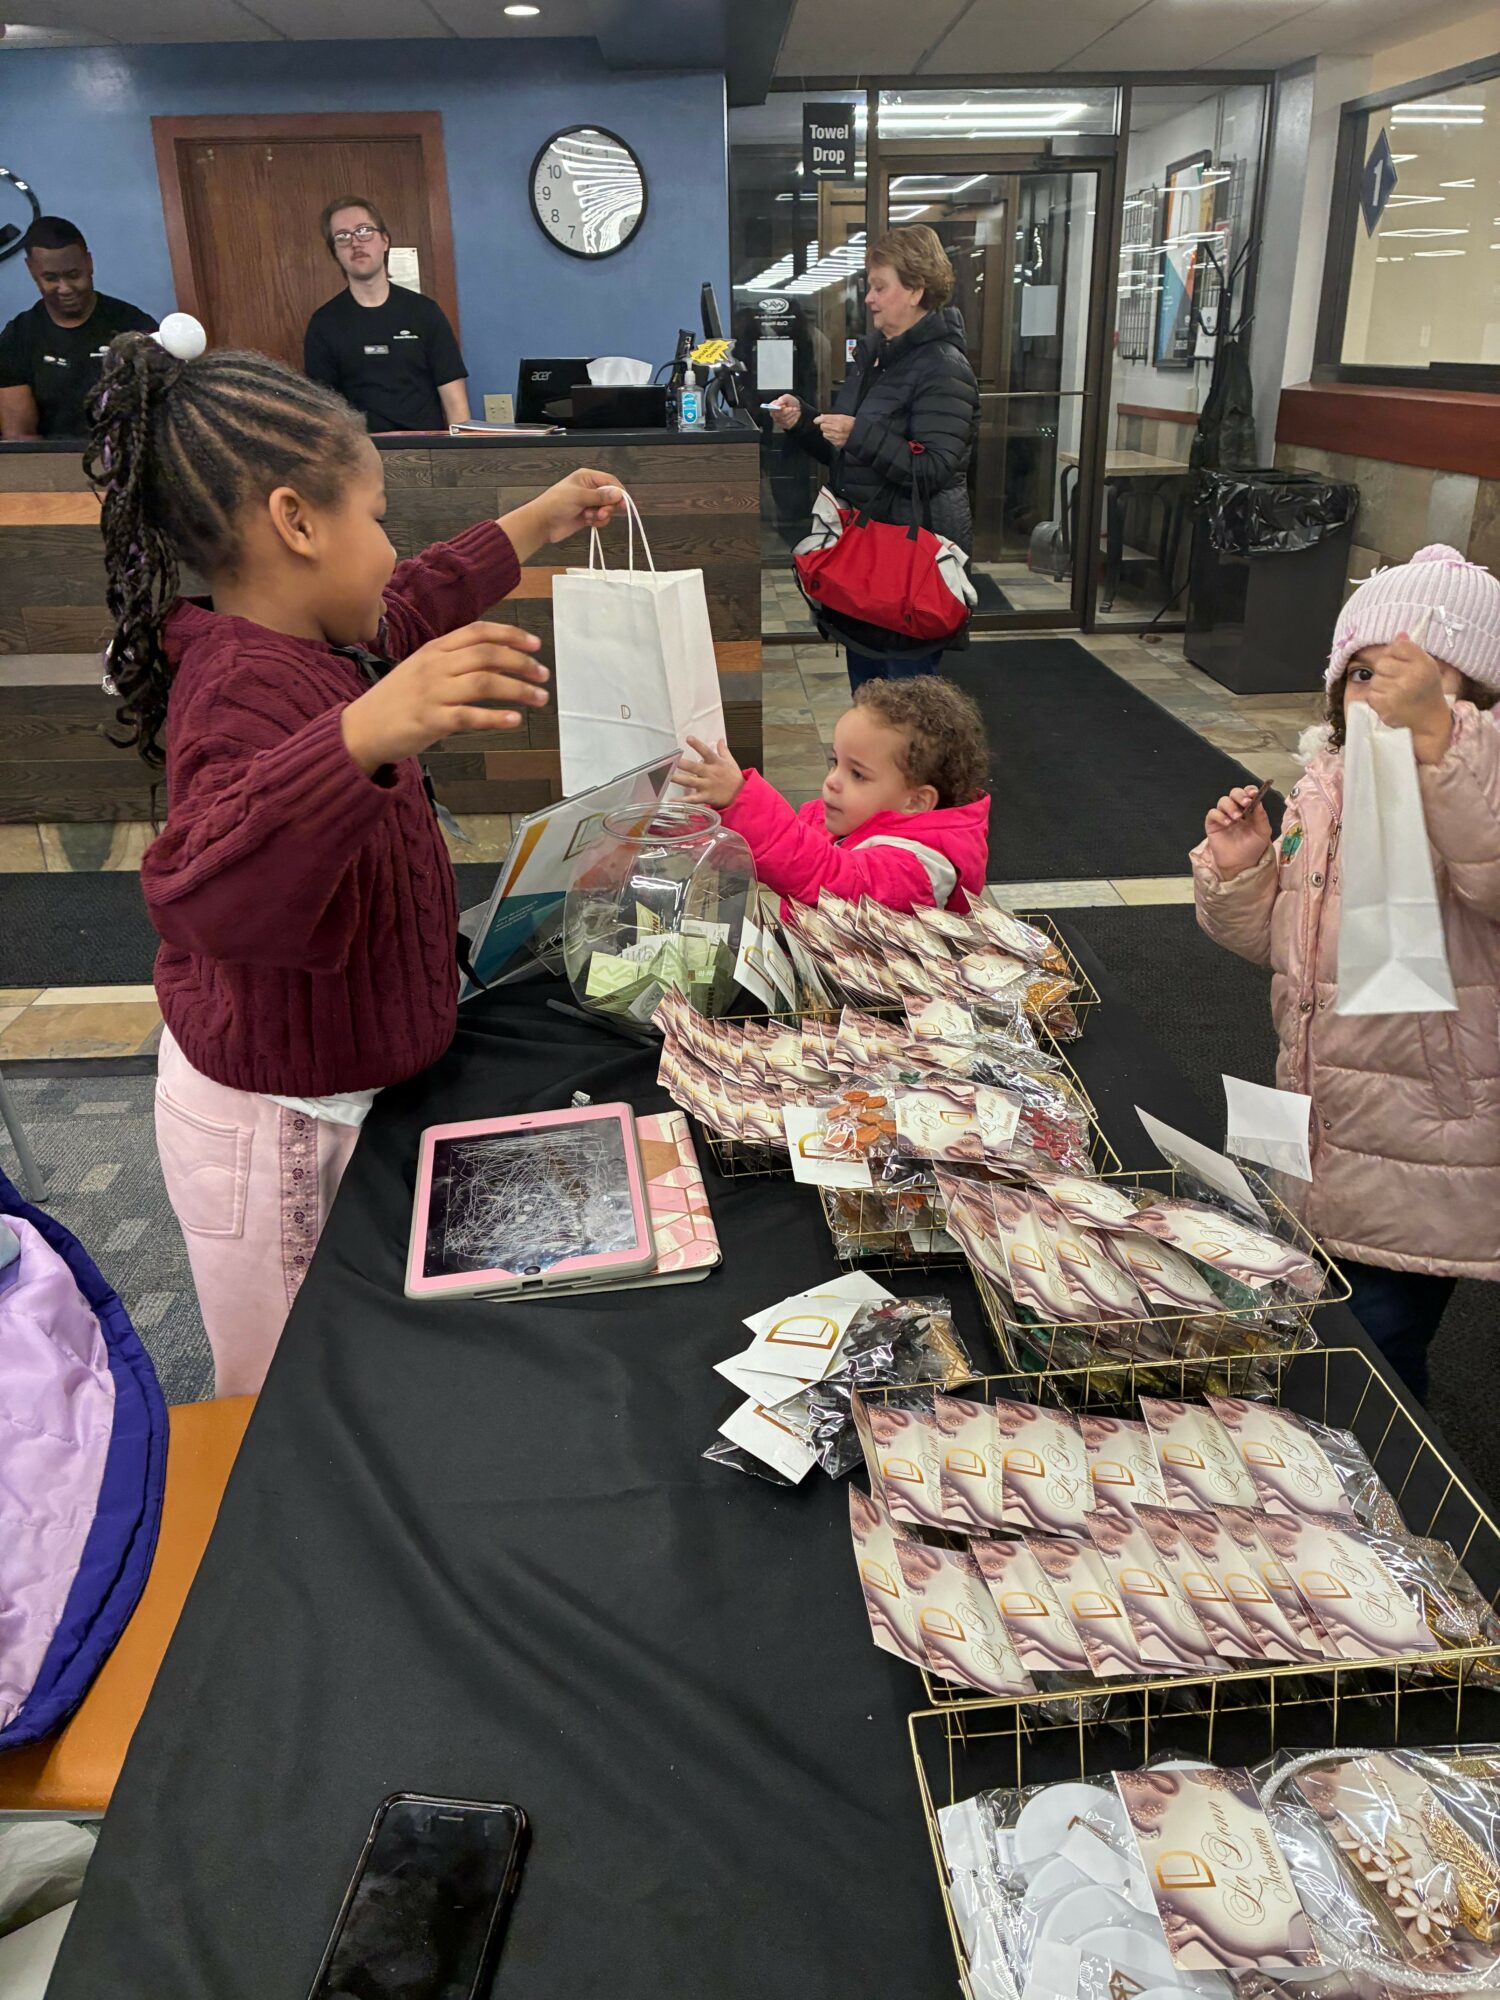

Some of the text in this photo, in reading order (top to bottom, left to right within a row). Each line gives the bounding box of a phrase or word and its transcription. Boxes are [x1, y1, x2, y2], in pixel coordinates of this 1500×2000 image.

[809, 124, 849, 139] Towel
[813, 146, 846, 165] Drop
[547, 164, 562, 179] 10
[1373, 159, 1384, 207] 1
[542, 186, 551, 201] 9
[551, 208, 560, 223] 8
[567, 225, 576, 239] 7
[531, 371, 552, 381] acer
[1200, 1800, 1266, 1927] La Donn
[1250, 1827, 1293, 1904] Accessories
